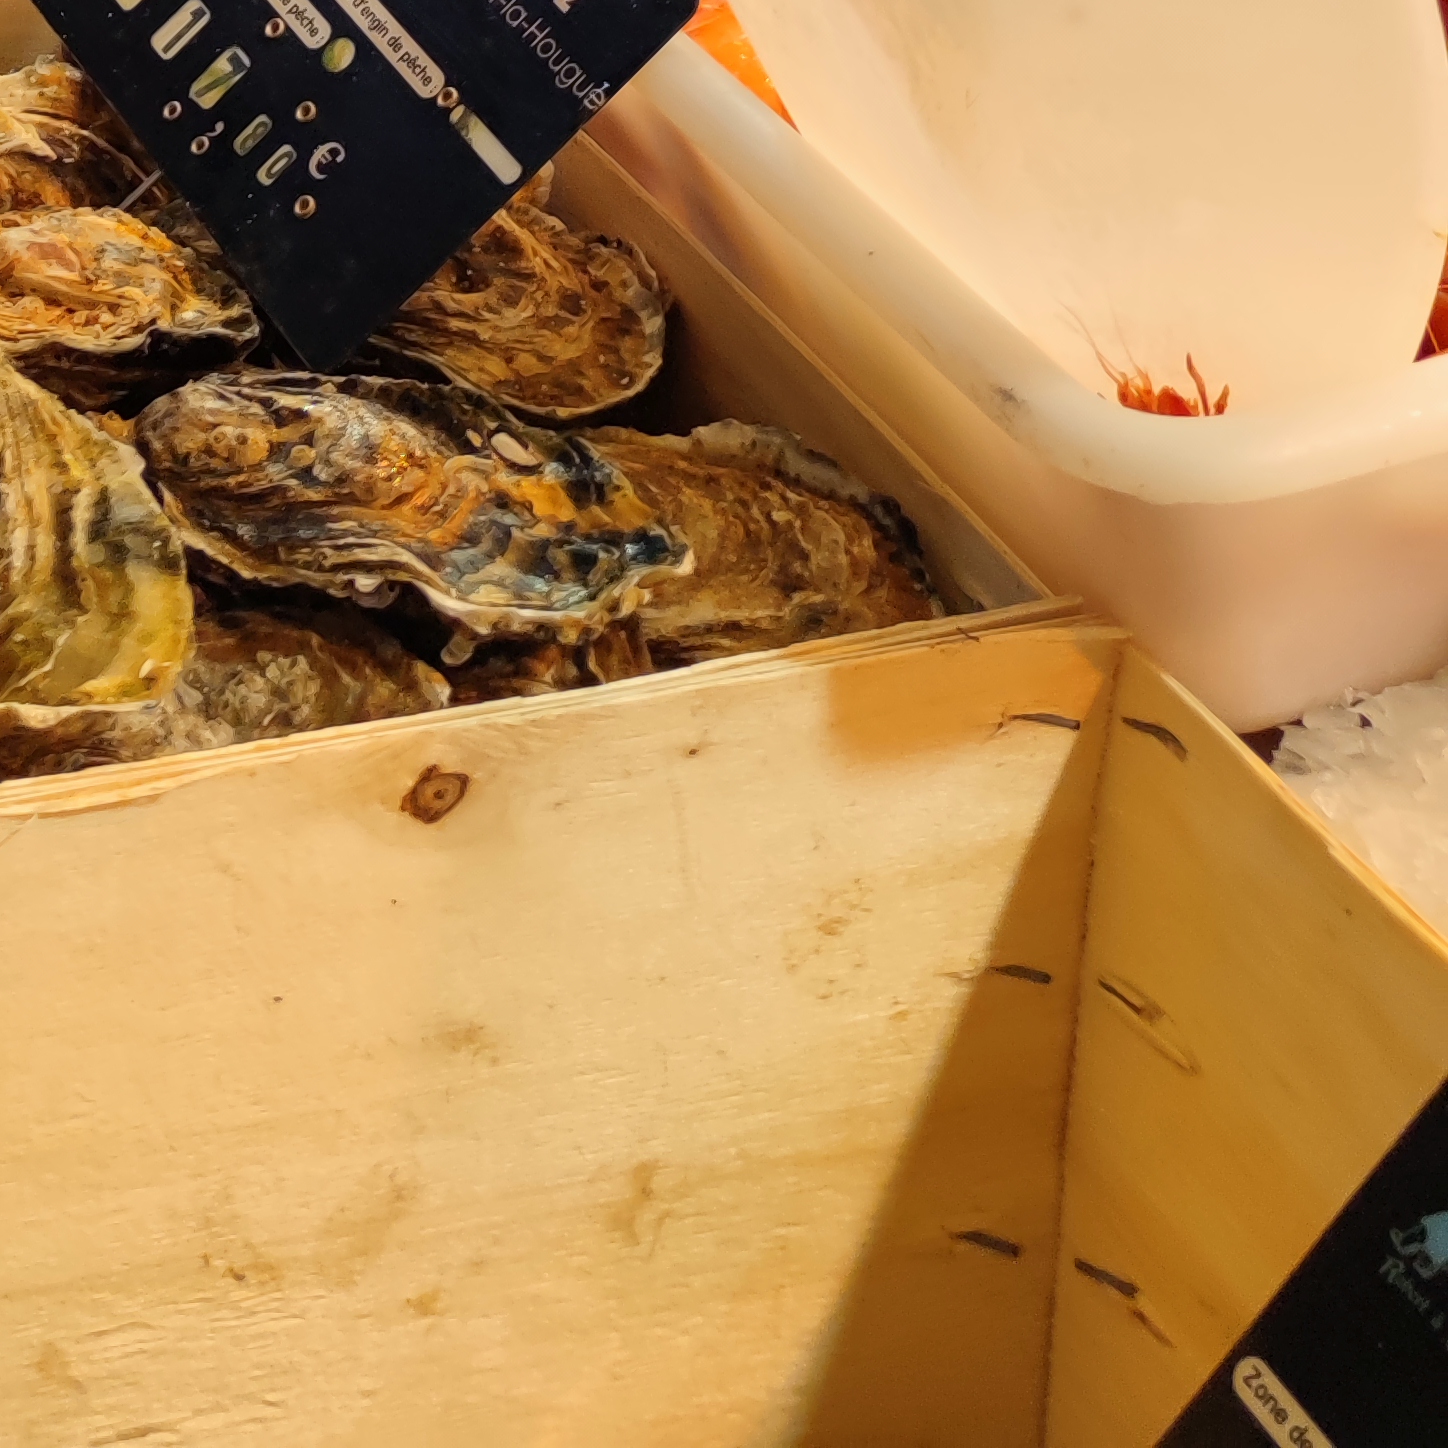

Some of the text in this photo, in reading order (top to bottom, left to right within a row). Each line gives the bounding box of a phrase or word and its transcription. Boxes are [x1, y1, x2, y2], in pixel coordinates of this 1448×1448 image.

[283, 0, 324, 42] pêche
[384, 32, 406, 55] de
[395, 47, 437, 91] pêche
[300, 135, 349, 183] €
[1241, 1363, 1289, 1427] Zone
